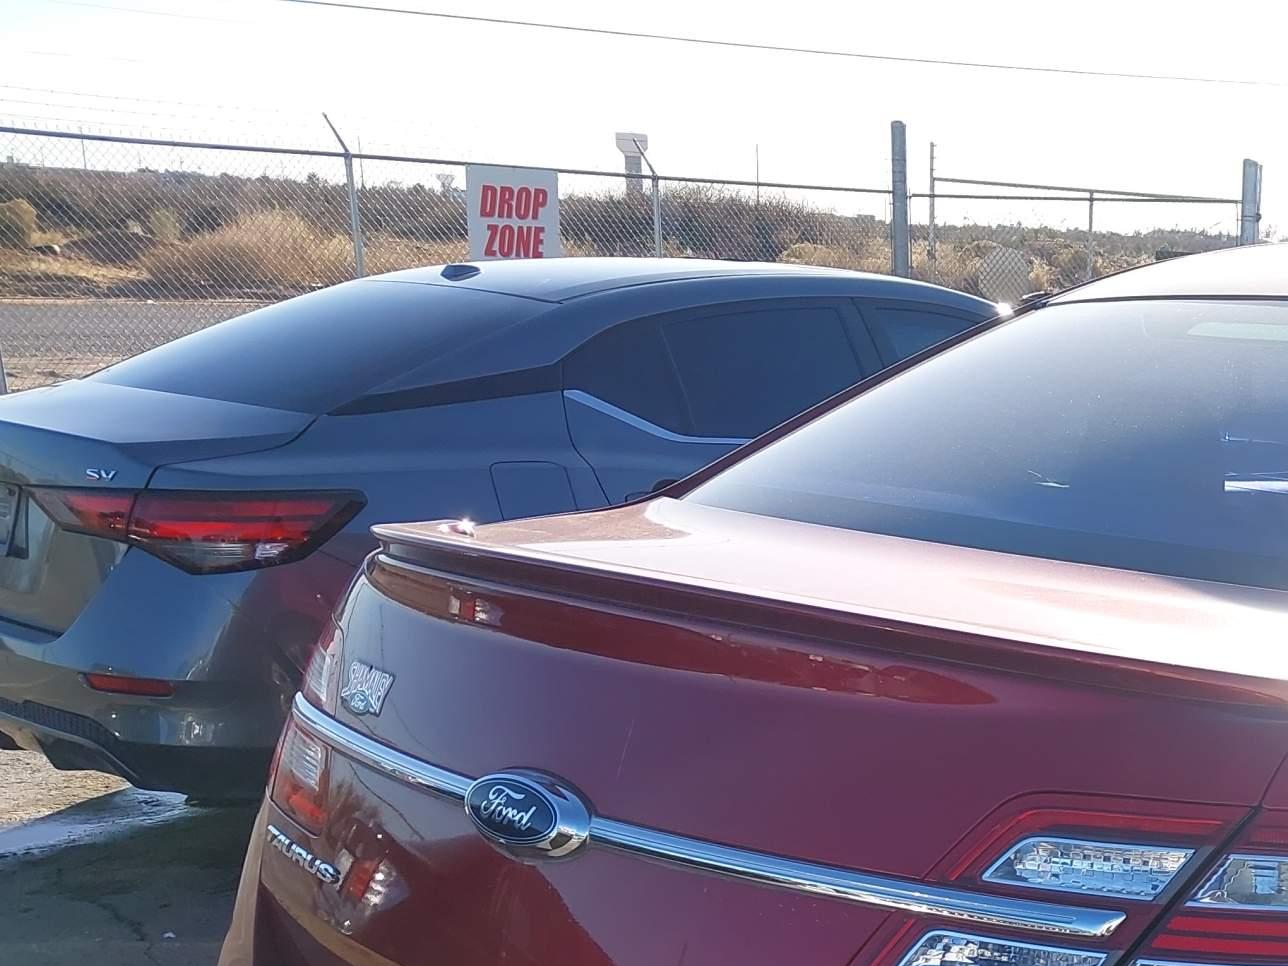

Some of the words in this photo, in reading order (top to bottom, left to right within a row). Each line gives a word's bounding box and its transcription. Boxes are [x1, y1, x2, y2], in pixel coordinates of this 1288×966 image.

[479, 184, 548, 221] DROP
[484, 223, 545, 259] ZONE
[86, 468, 117, 481] SV
[480, 785, 538, 831] Ford
[266, 824, 341, 884] TAURUS
